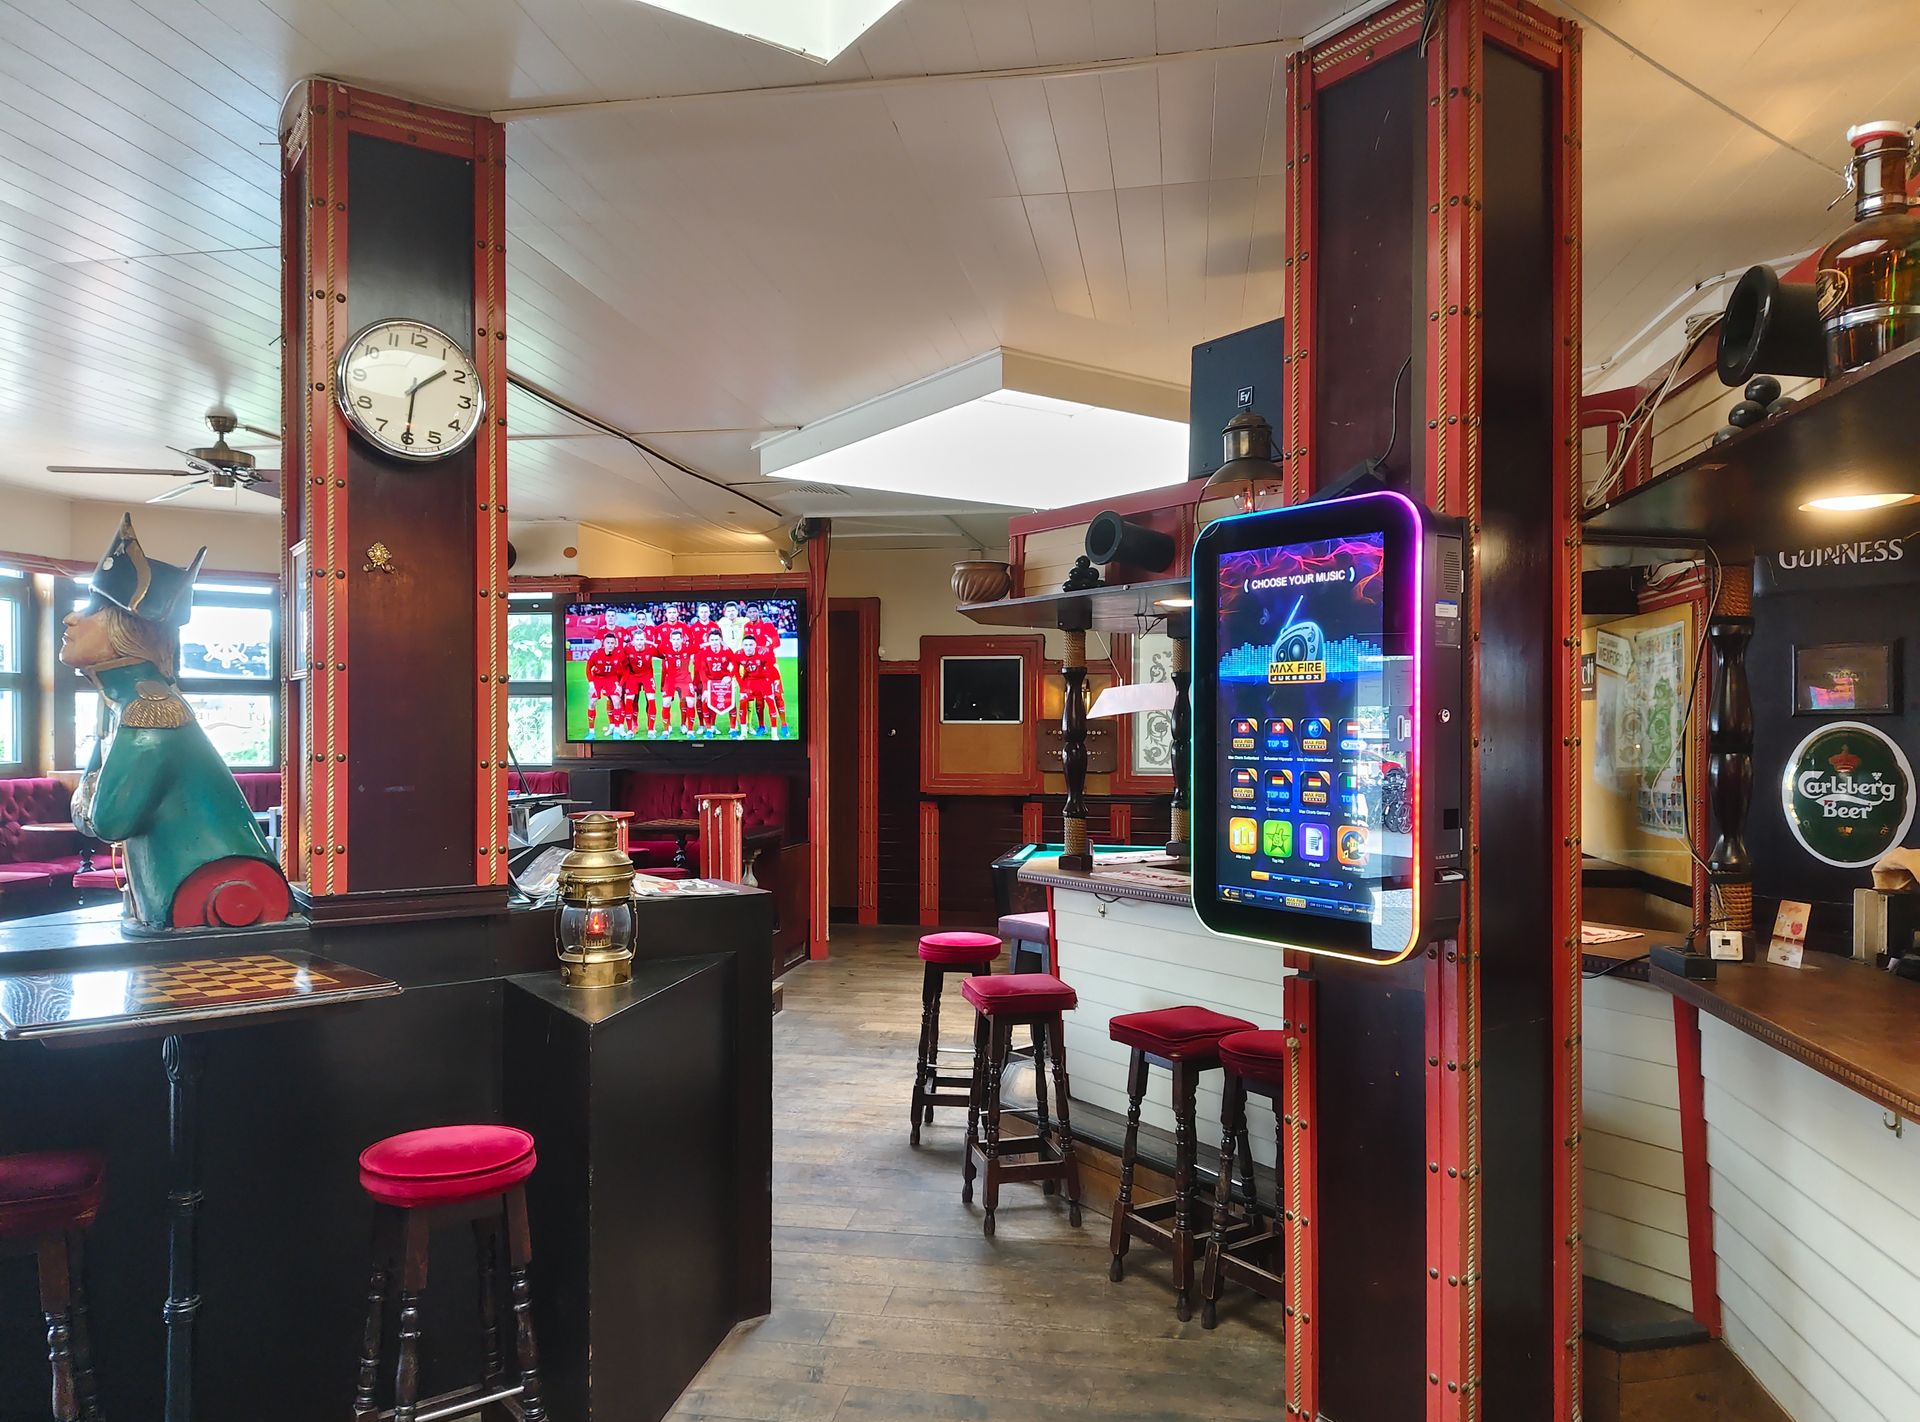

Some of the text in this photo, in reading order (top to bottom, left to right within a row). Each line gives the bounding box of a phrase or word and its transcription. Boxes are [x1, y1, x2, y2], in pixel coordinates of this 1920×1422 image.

[388, 333, 399, 347] 11
[410, 332, 429, 349] 12
[365, 345, 380, 359] 10
[442, 348, 447, 361] 1
[353, 369, 367, 382] 9
[452, 370, 466, 384] 2
[356, 396, 373, 410] 8
[457, 396, 472, 410] 3
[375, 418, 389, 432] 7
[447, 419, 461, 432] 4
[400, 431, 415, 445] 6
[427, 430, 442, 445] 5
[1778, 538, 1904, 569] GUINNESS
[1251, 569, 1346, 590] CHOOSE YOUR MUSIC
[637, 660, 643, 668] 3
[712, 662, 722, 672] 22
[1270, 662, 1322, 674] MAX FIRE
[1267, 740, 1280, 748] TOP
[1798, 770, 1896, 801] Carlsberg
[1266, 791, 1279, 799] TOP
[1823, 800, 1873, 819] Beer
